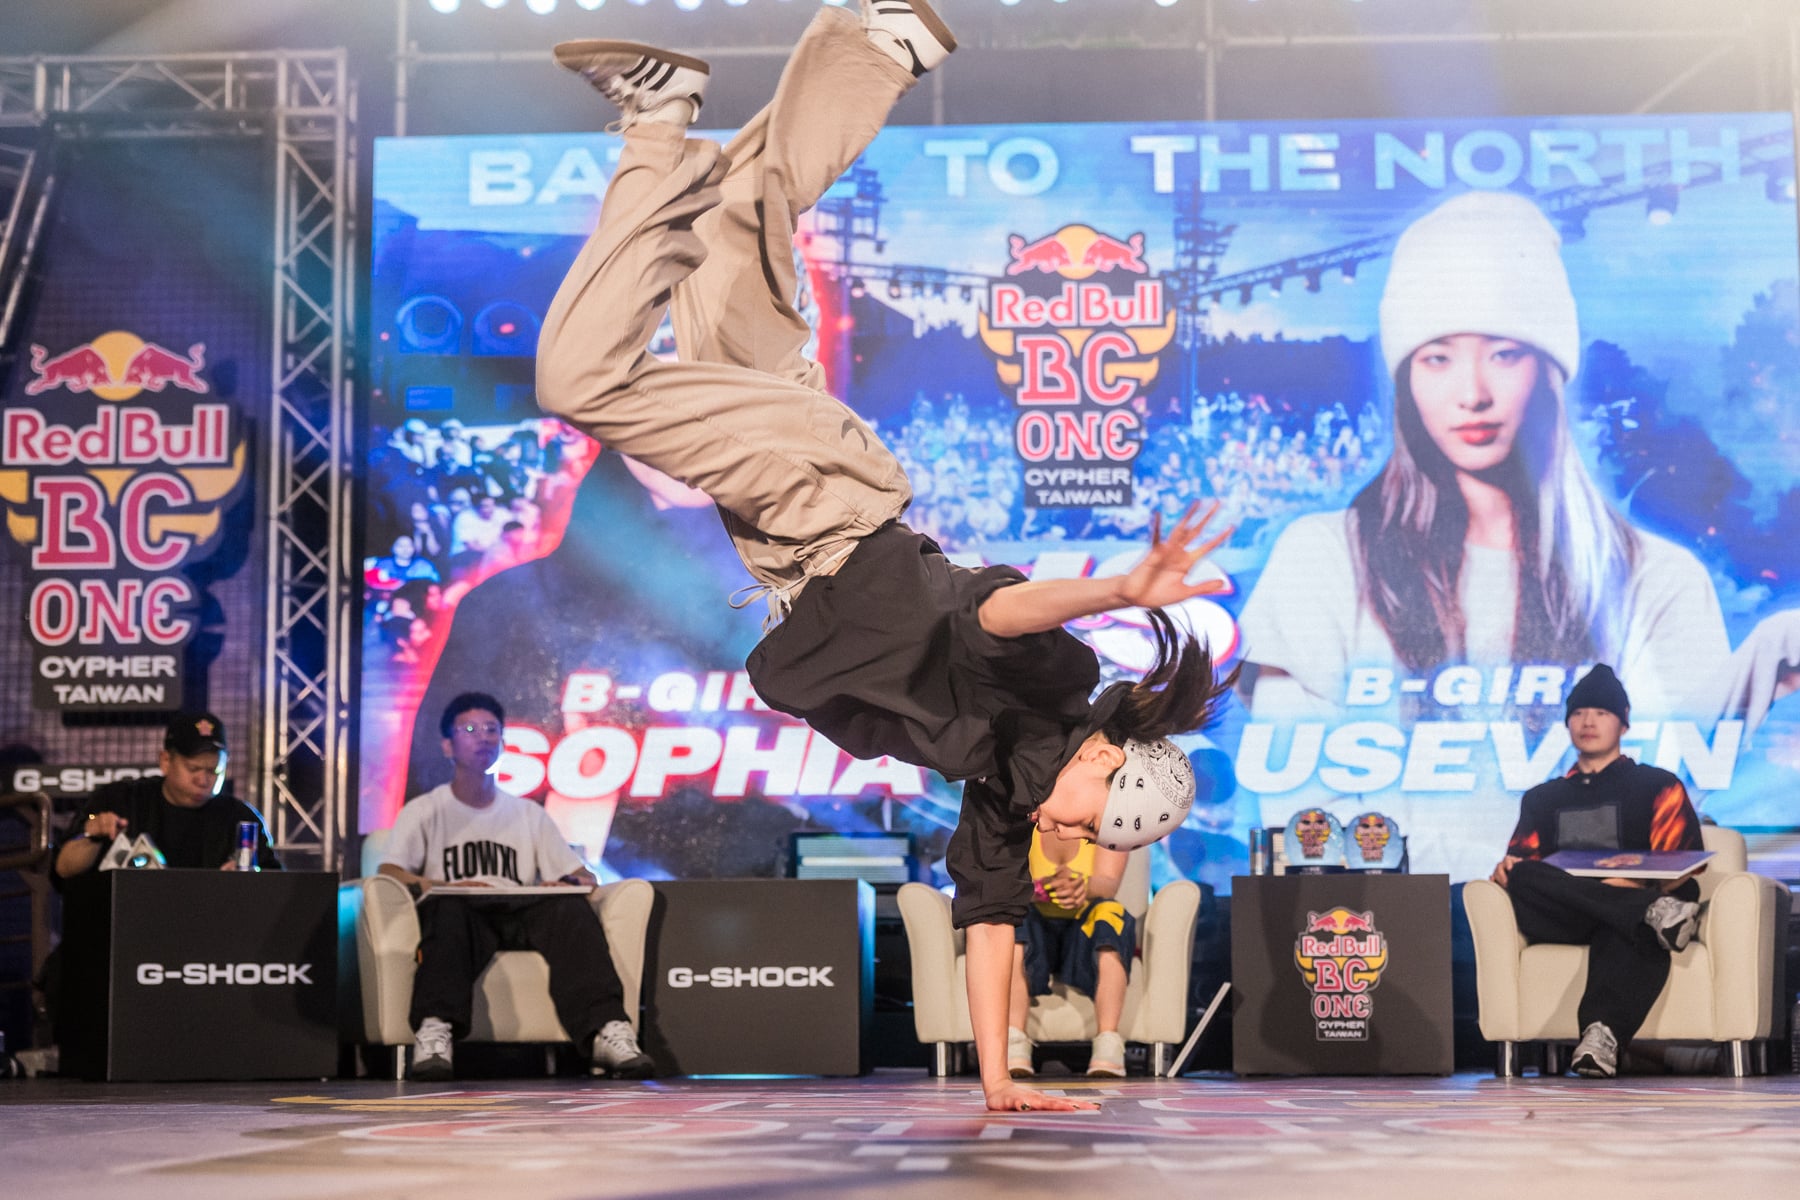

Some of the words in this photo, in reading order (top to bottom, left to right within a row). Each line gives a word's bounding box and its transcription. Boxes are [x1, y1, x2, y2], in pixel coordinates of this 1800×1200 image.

[925, 139, 1059, 198] TO
[1130, 134, 1341, 194] THE
[1374, 128, 1740, 190] NORTH
[991, 281, 1078, 327] Red
[1079, 280, 1163, 327] Bull
[1017, 332, 1137, 406] BC
[3, 405, 117, 465] Red
[118, 404, 229, 464] Bull
[1016, 410, 1140, 462] ONE
[1024, 468, 1132, 487] CYPHER
[1035, 489, 1123, 505] TAIWAN
[32, 472, 193, 571] BC
[29, 577, 192, 646] ONE
[39, 655, 177, 679] CYPHER
[53, 684, 165, 704] TAIWAN
[561, 671, 771, 712] B-GIR
[1345, 665, 1595, 706] B-GIR
[494, 726, 924, 799] SOPHIA
[13, 768, 165, 792] G-SH
[1302, 935, 1341, 956] Red
[1341, 935, 1380, 956] Bull
[136, 963, 313, 985] G-SHOCK
[668, 966, 835, 988] G-SHOCK
[1313, 958, 1369, 993] BC
[1314, 994, 1370, 1018] ONE
[1318, 1021, 1365, 1029] CYPHER
[1323, 1030, 1362, 1038] TAIWAN
